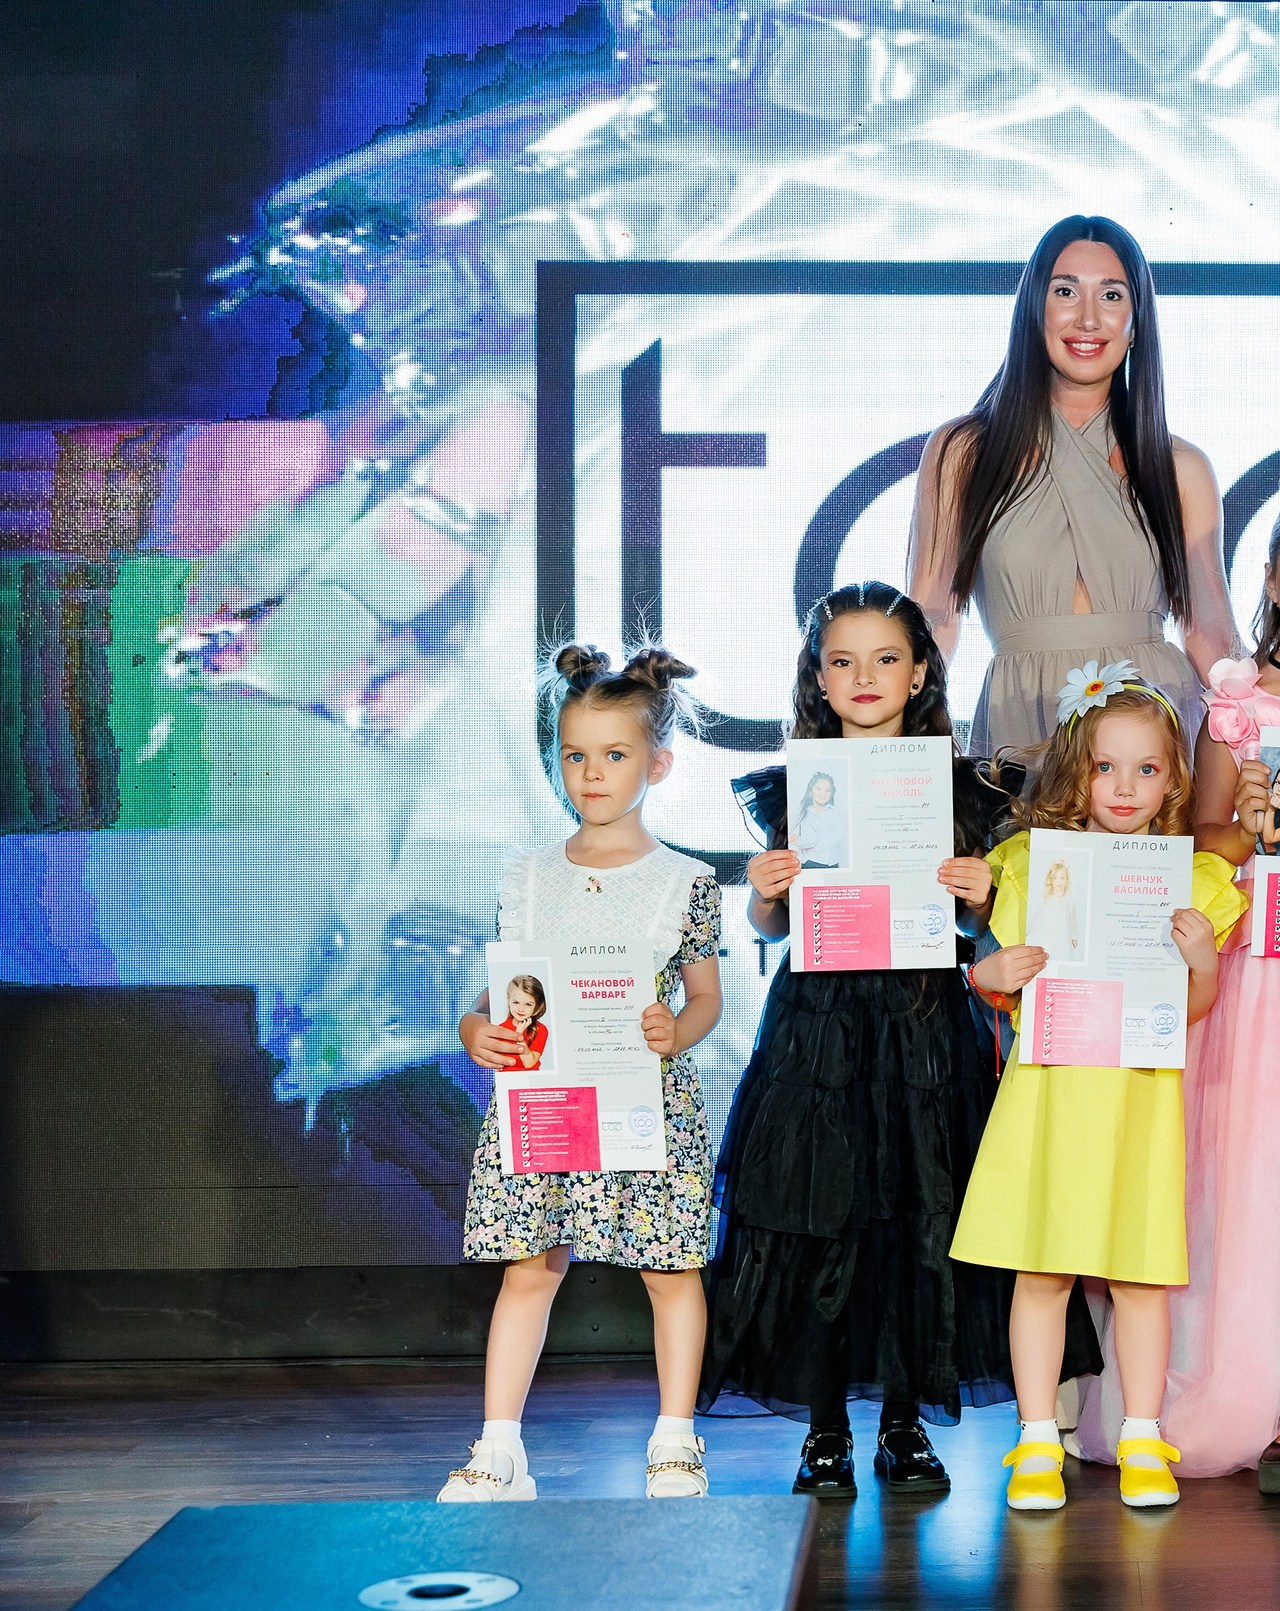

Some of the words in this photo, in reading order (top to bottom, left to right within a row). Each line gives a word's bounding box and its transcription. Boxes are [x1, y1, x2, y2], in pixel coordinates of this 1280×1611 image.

[870, 743, 927, 755] ДИПЛОМ
[879, 788, 924, 798] НИКОЛЬ
[1112, 840, 1169, 851] ДИПЛОМ
[1120, 874, 1163, 884] ШЕВЧУК
[1113, 885, 1169, 896] ВАСИЛИСЕ
[570, 945, 627, 957] ДИПЛОМ
[570, 976, 635, 988] ЧЕКАНОВОЙ
[581, 990, 626, 999] ВАРВАРЕ
